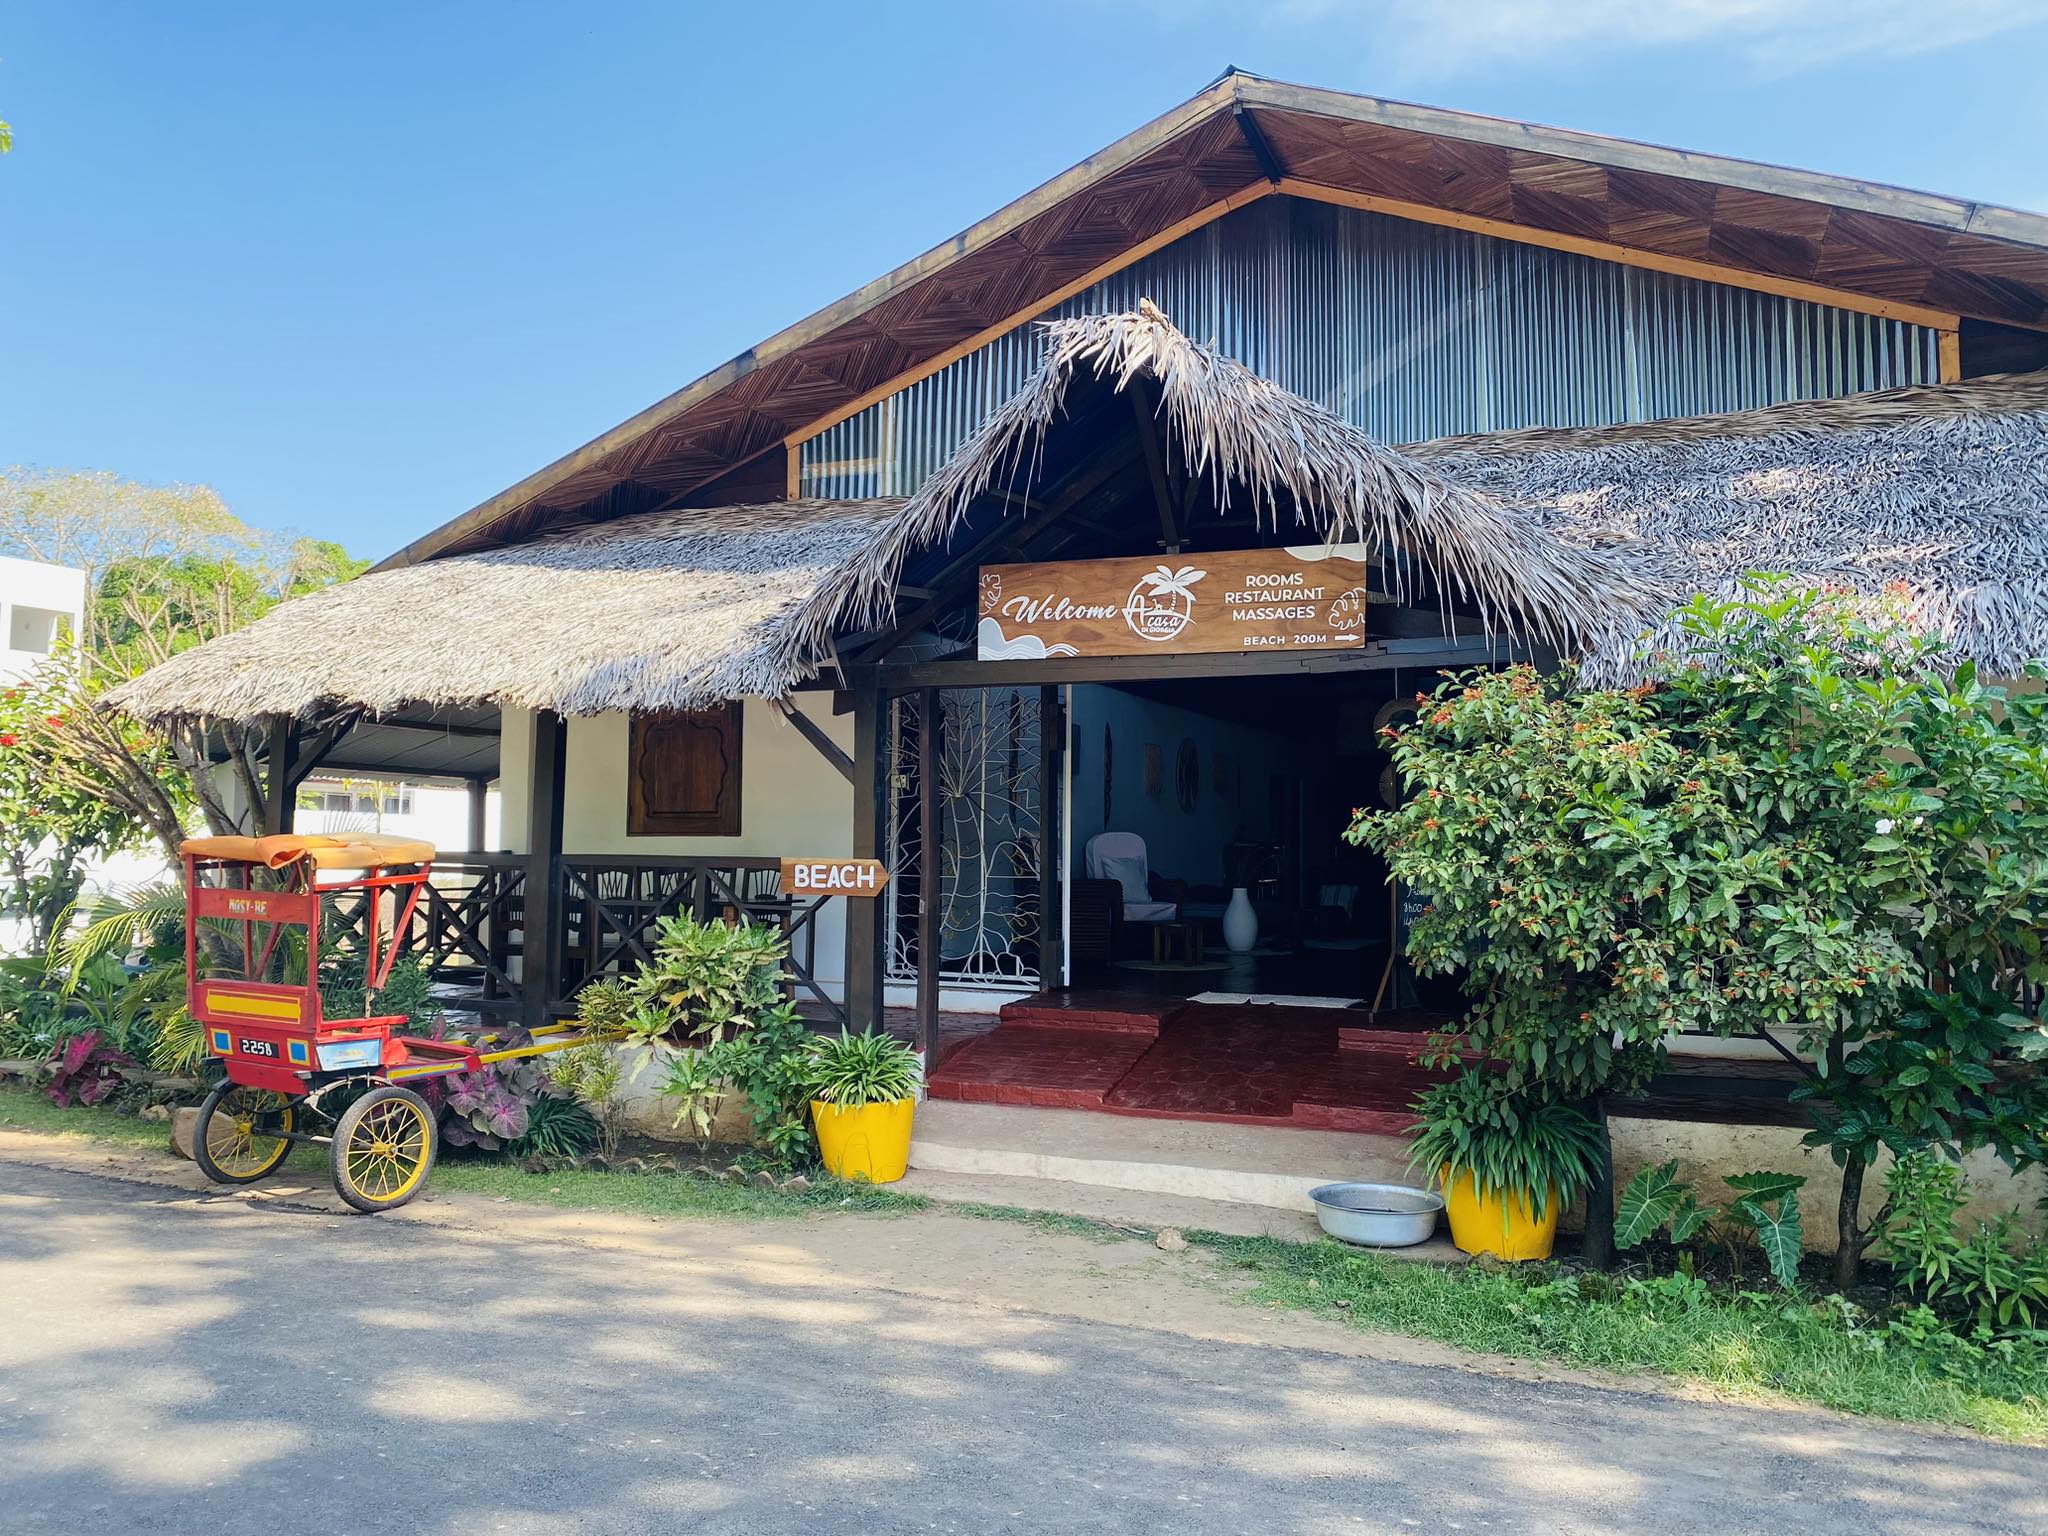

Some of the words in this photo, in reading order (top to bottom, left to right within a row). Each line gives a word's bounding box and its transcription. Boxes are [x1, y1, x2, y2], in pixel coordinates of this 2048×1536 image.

[1245, 572, 1304, 587] ROOMS
[1224, 587, 1325, 604] RESTAURANT
[1001, 594, 1119, 625] Welcome
[1232, 605, 1316, 621] MASSAGES
[1243, 635, 1286, 646] BEACH
[1293, 634, 1327, 644] 200M
[794, 863, 875, 889] BEACH
[241, 1039, 273, 1057] 2258
